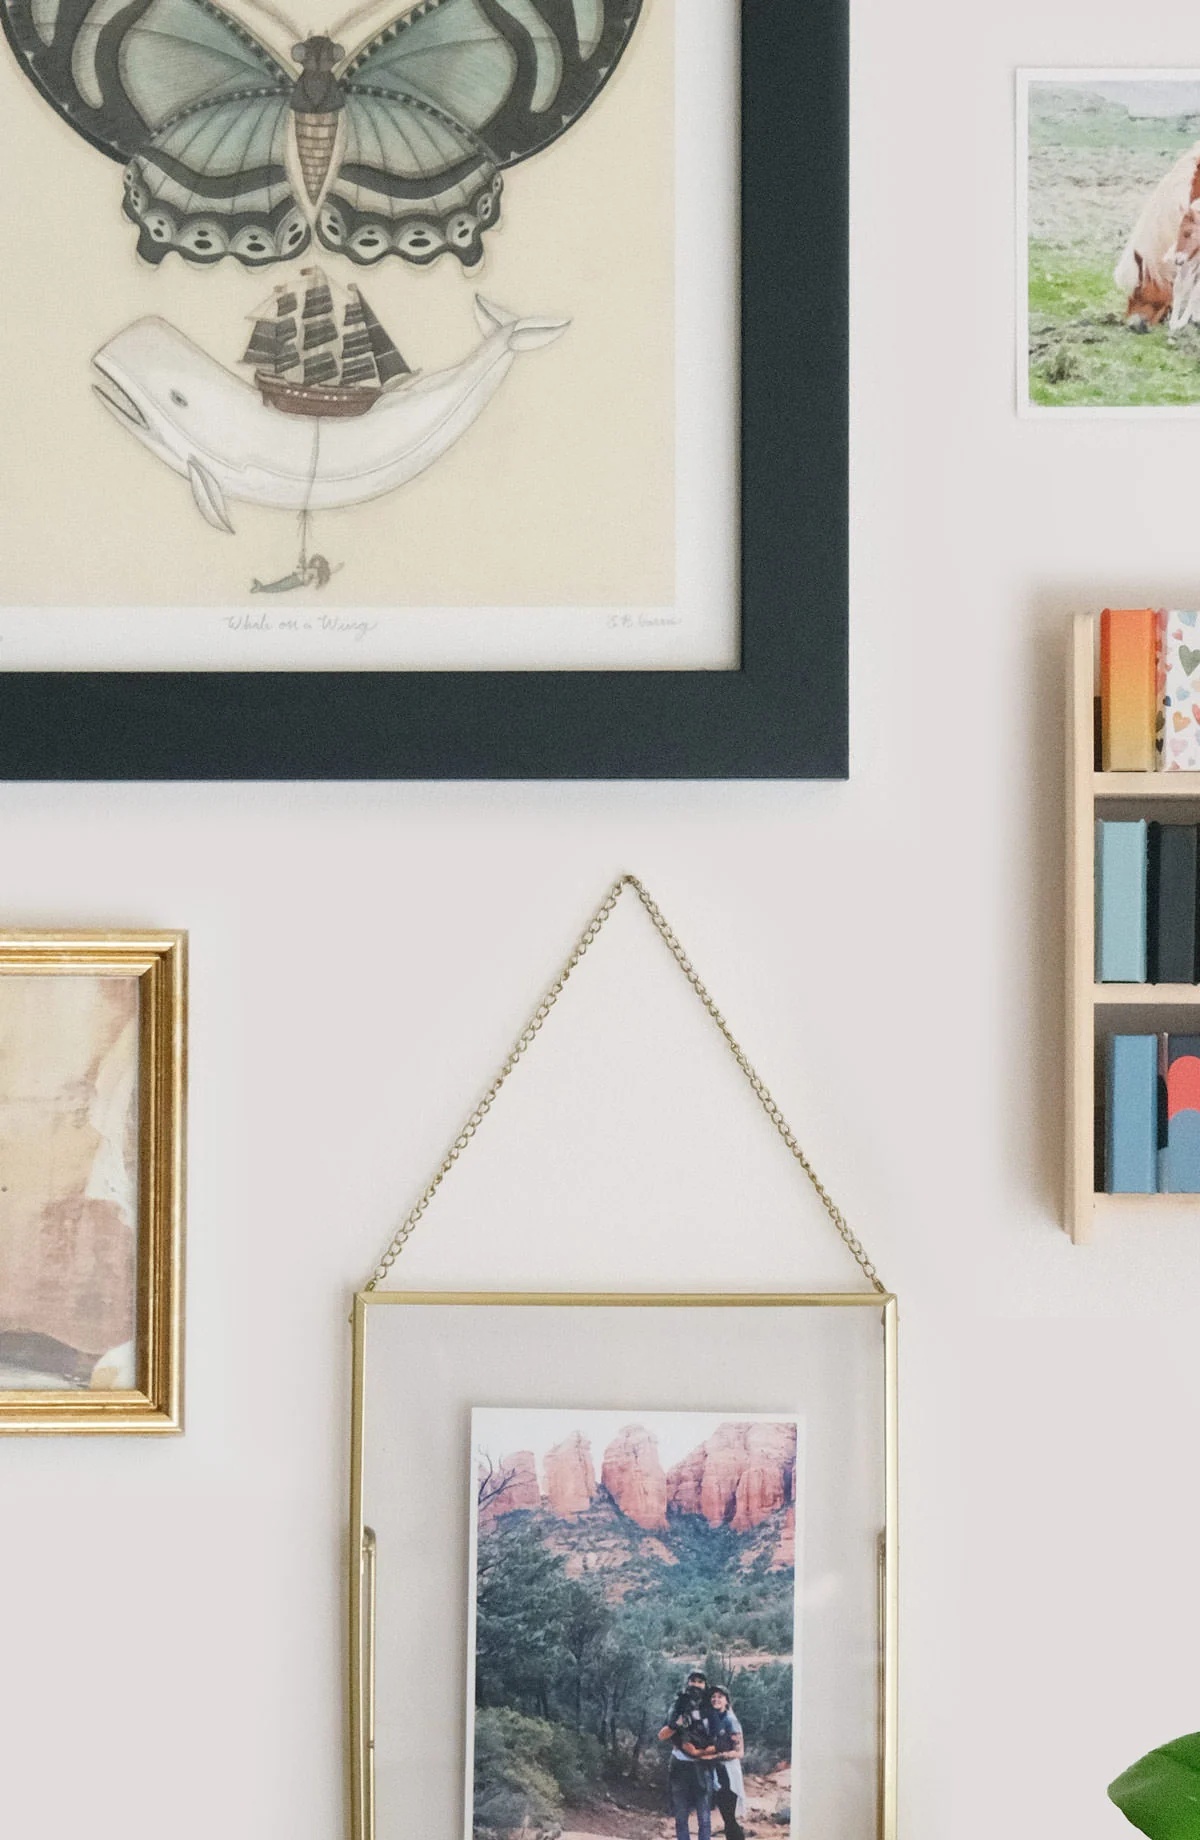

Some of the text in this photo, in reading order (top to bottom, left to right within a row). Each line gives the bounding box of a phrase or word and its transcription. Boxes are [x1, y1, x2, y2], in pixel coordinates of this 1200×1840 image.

[279, 619, 298, 630] on
[303, 621, 312, 630] a
[318, 614, 378, 642] Wing
